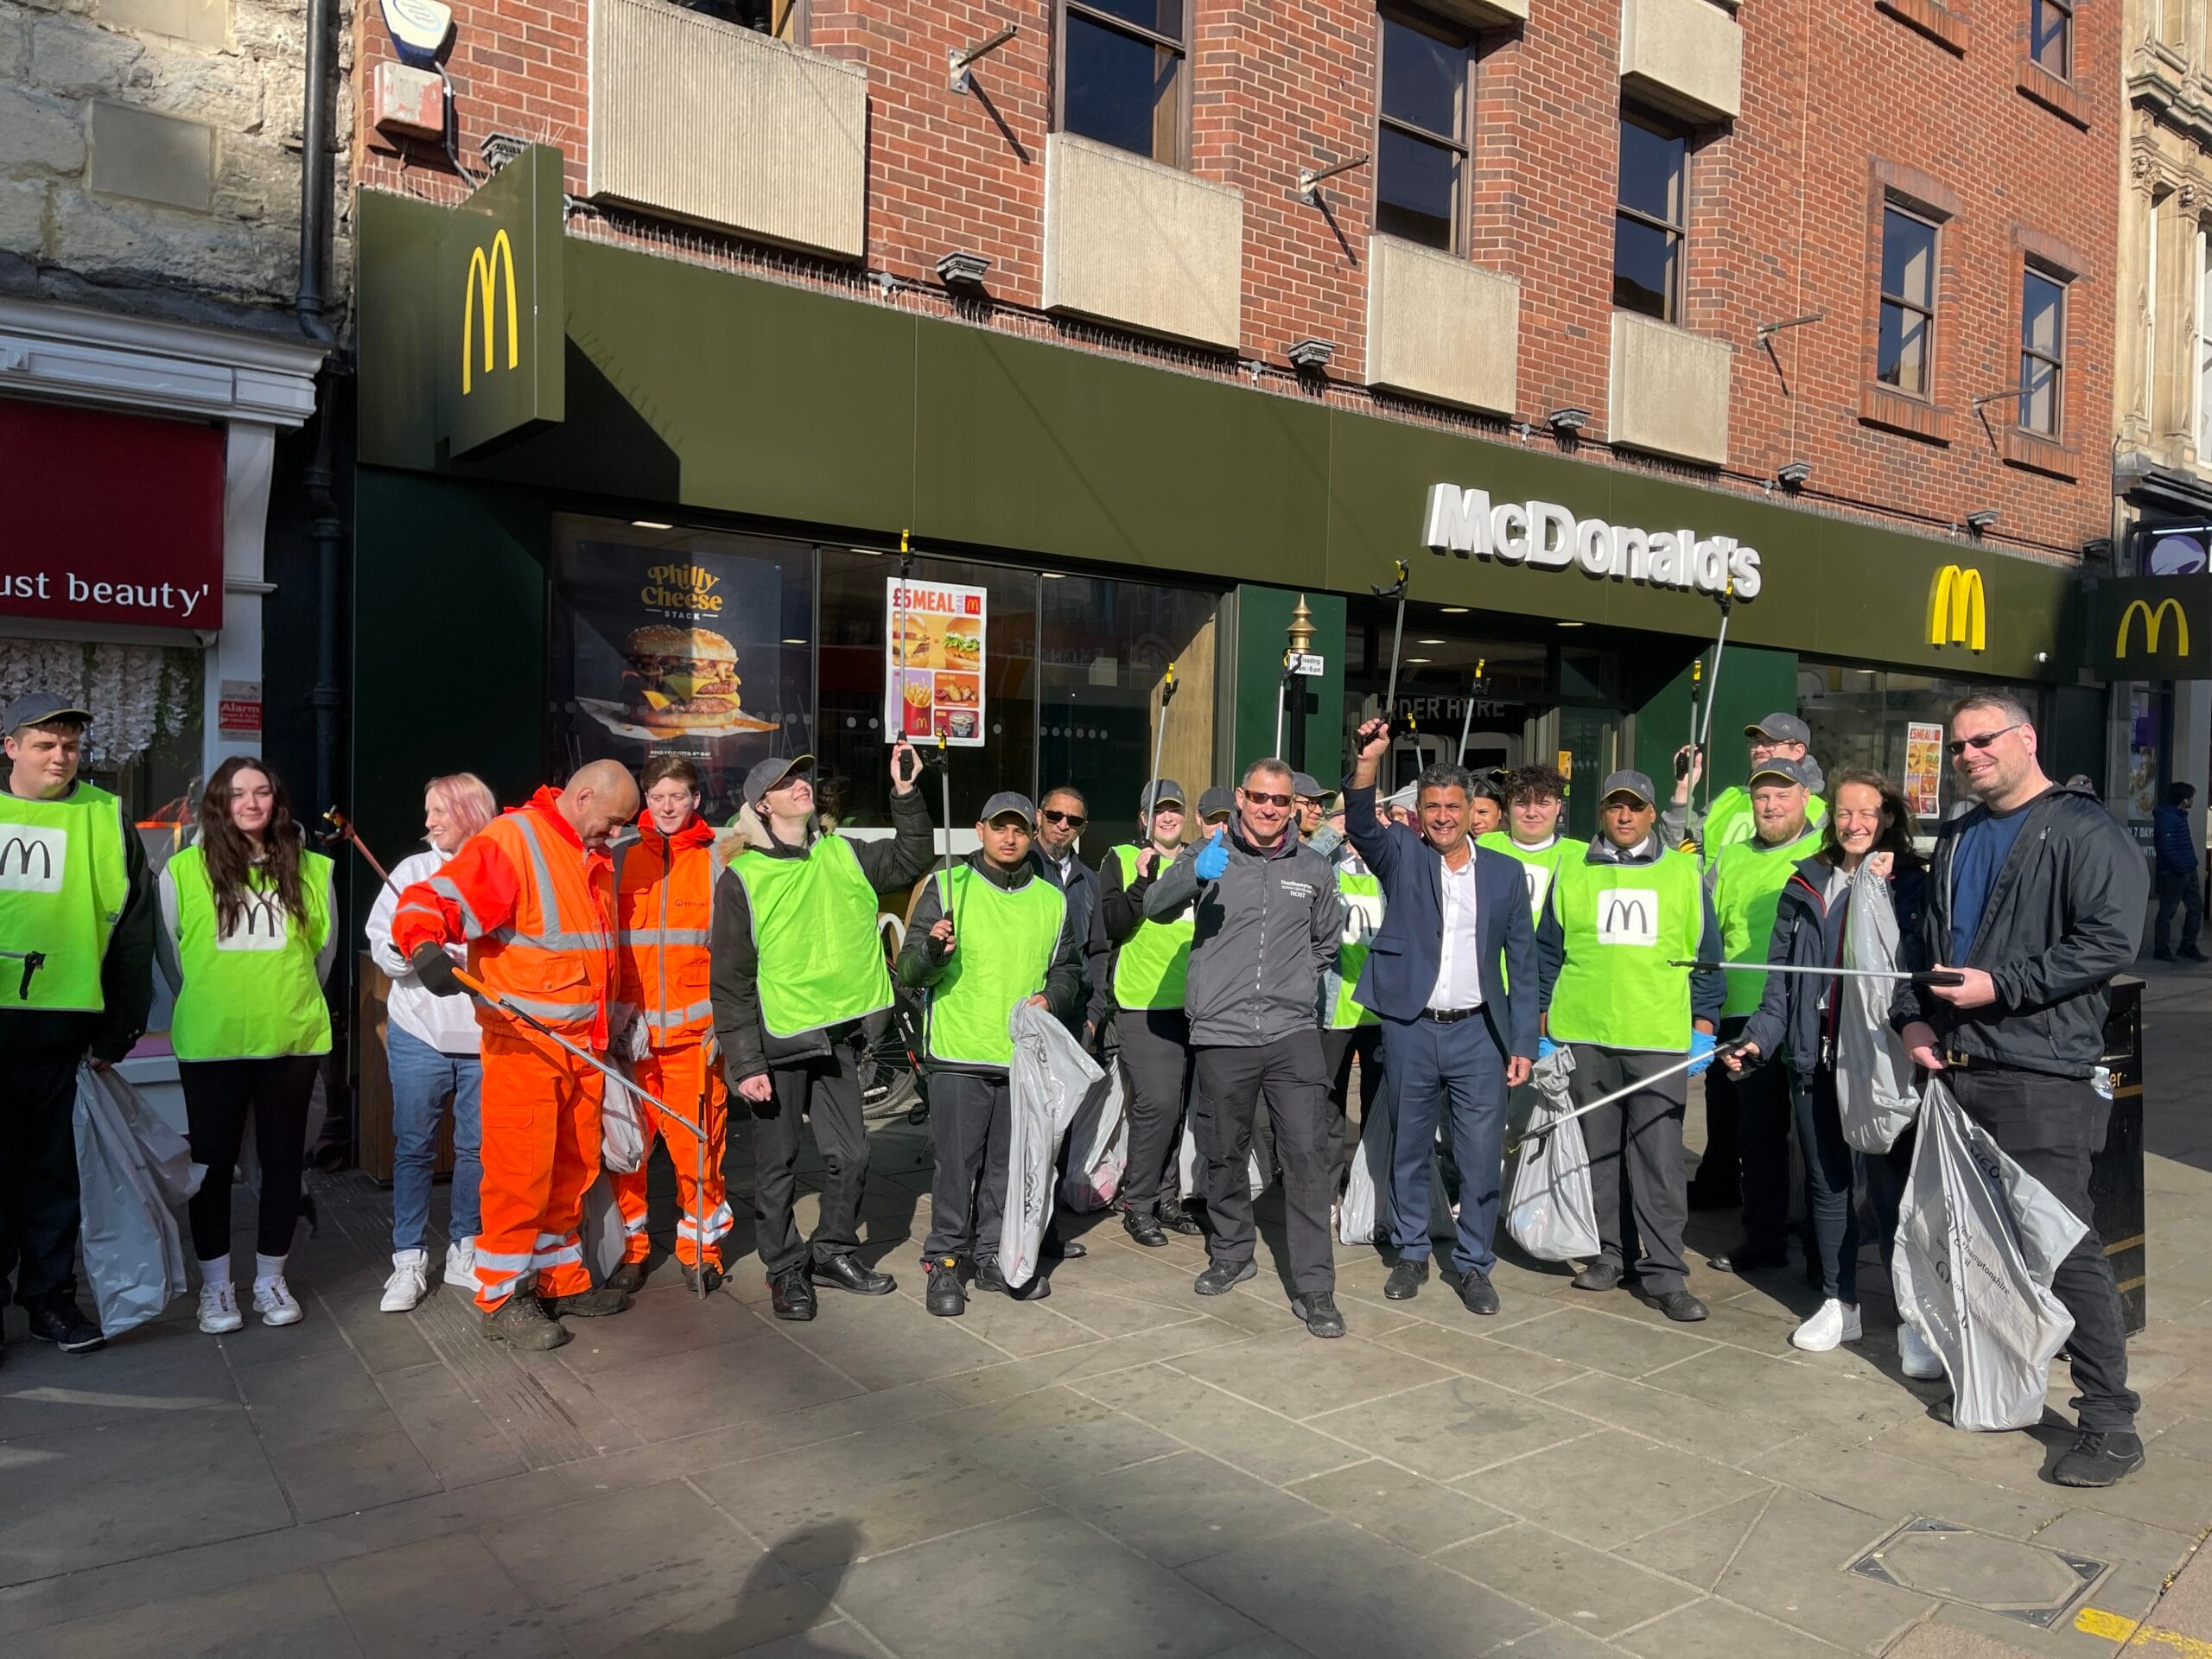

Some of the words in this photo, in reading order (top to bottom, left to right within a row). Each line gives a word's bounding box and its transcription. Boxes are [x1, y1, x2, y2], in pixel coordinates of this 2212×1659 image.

[1426, 482, 1762, 600] McDonald's
[647, 563, 721, 594] Philly
[66, 572, 209, 617] beauty'
[640, 586, 723, 612] Cheese
[912, 589, 955, 613] MEAL
[664, 610, 700, 620] STACK
[221, 702, 259, 713] Alarm
[1380, 696, 1440, 721] RDER
[1290, 890, 1306, 899] HOST
